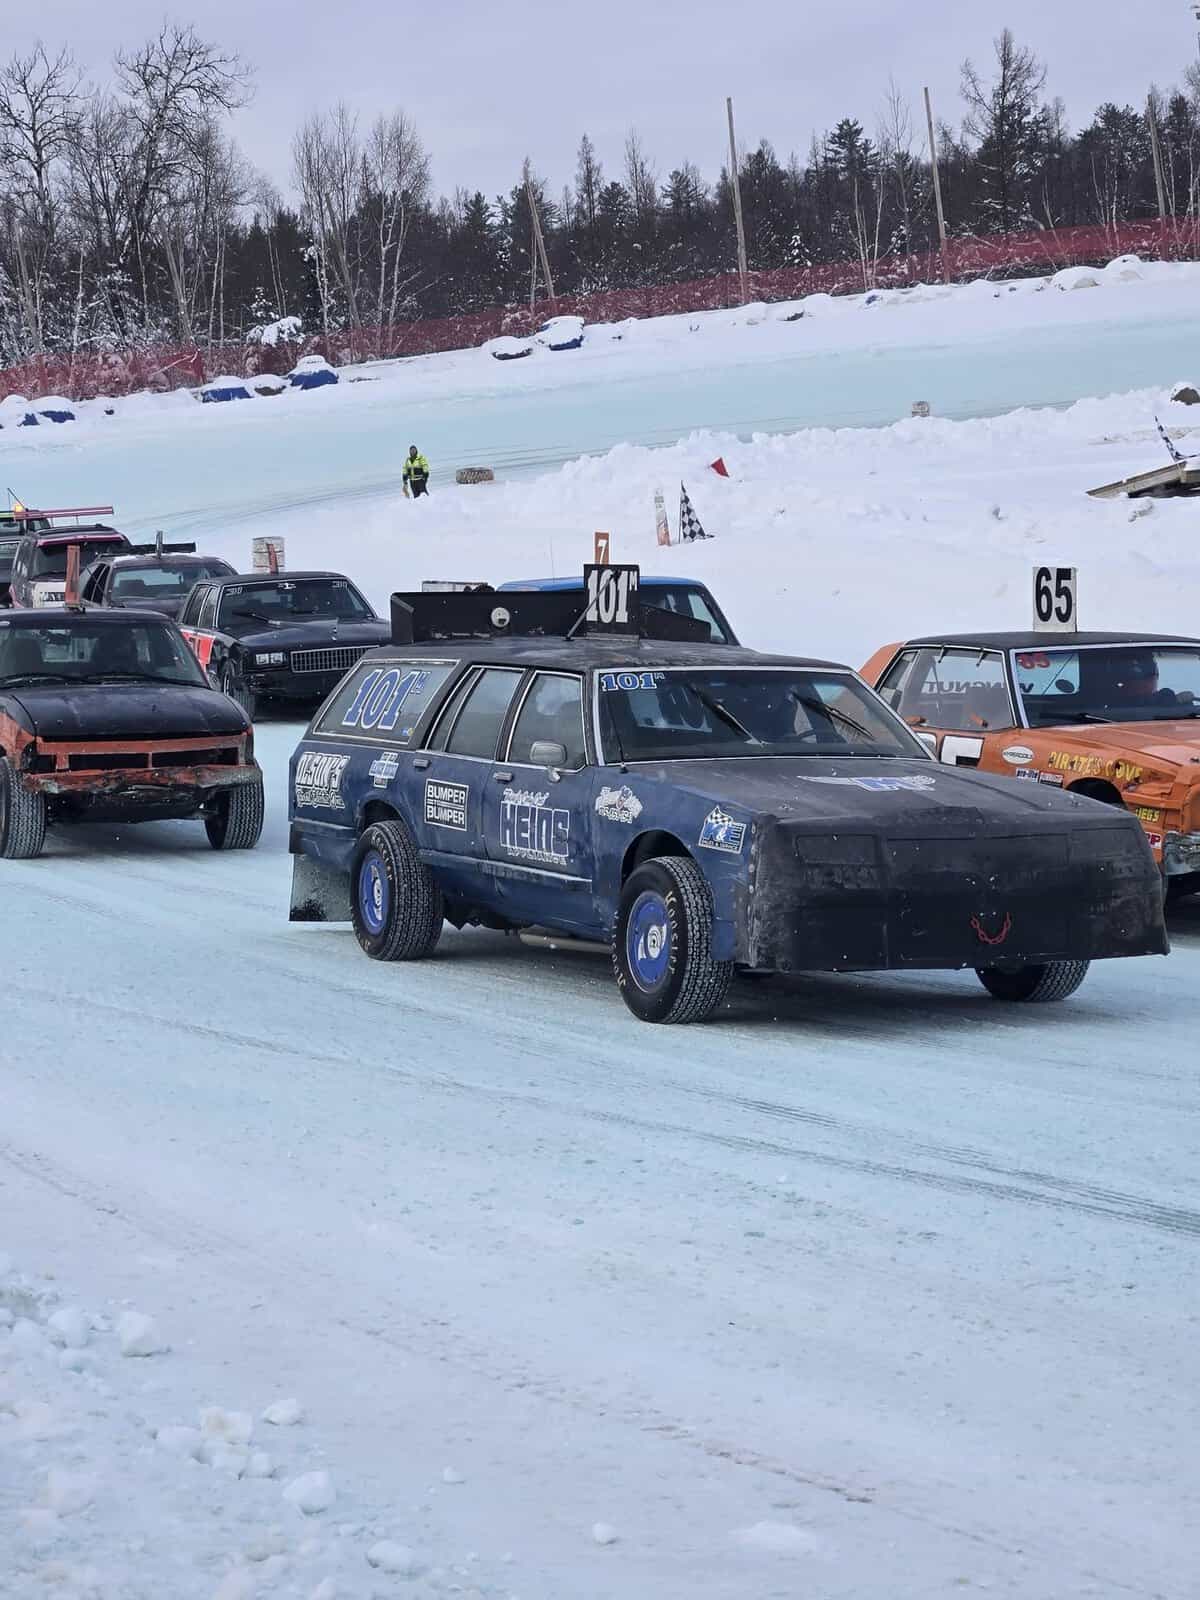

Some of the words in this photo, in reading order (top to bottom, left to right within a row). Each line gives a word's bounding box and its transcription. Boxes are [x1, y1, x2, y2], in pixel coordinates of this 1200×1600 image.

[597, 539, 608, 565] 7
[1035, 566, 1073, 623] 65
[427, 784, 466, 804] BUMPER
[426, 805, 465, 825] BUMPER
